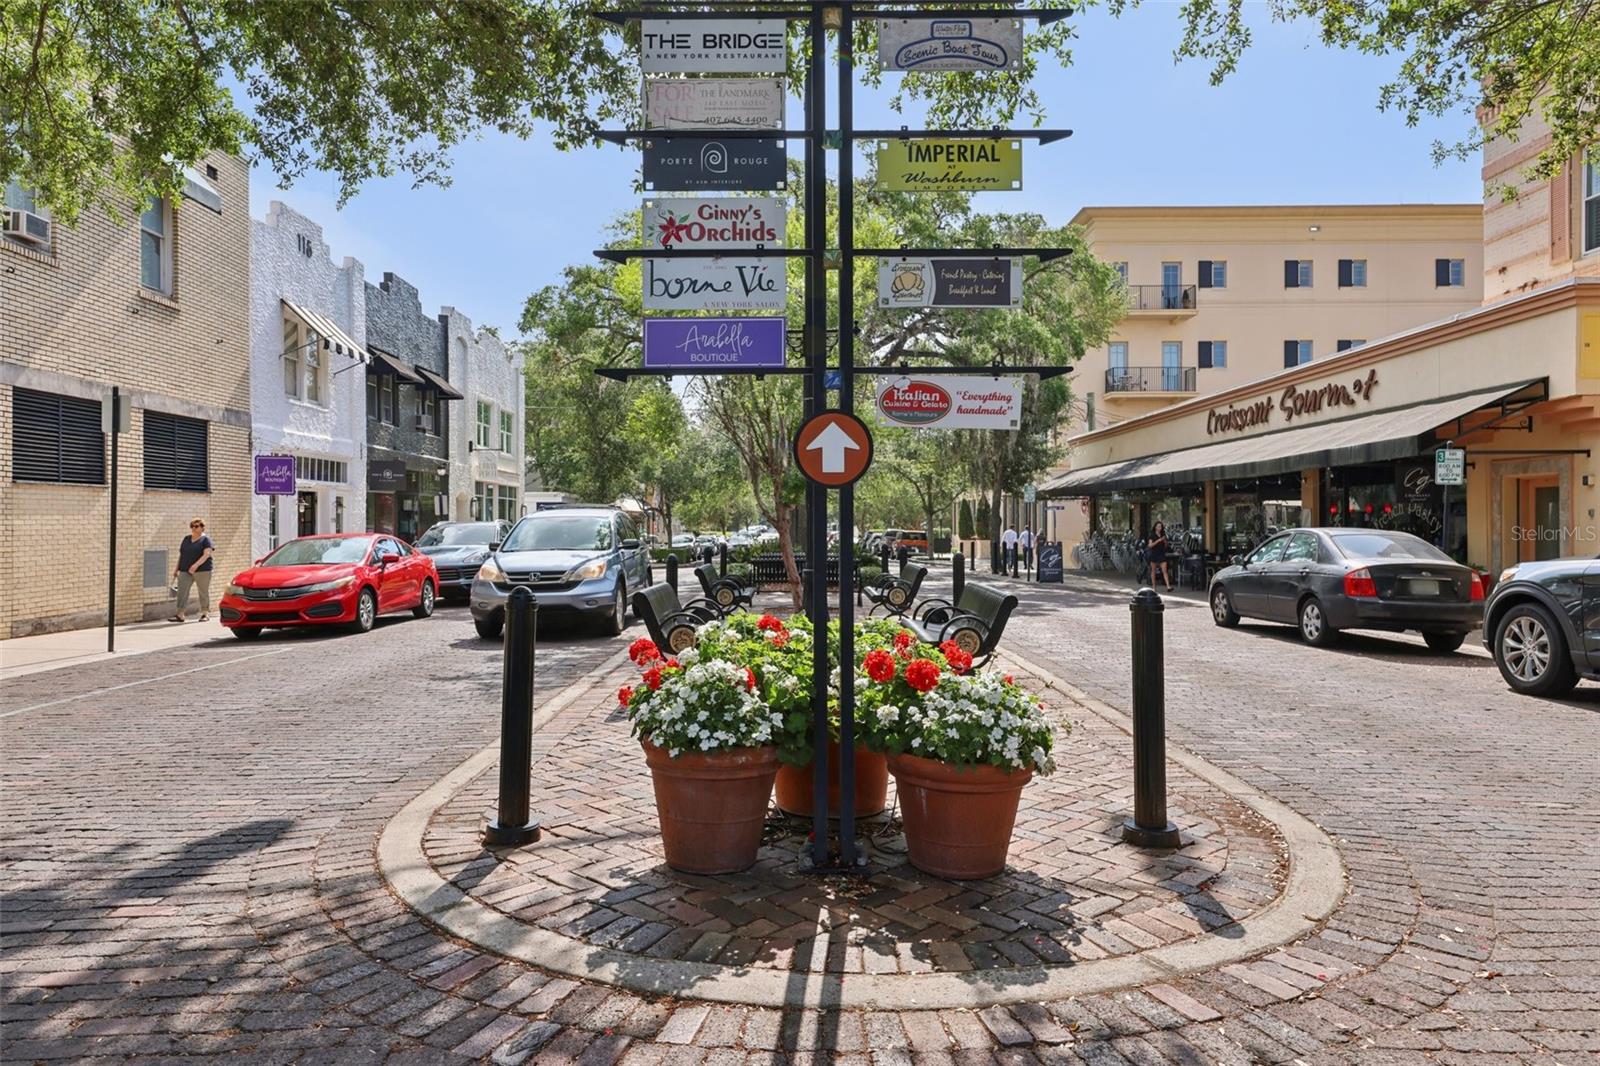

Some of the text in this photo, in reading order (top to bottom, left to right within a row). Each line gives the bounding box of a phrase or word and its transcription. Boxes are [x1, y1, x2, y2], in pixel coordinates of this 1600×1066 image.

[644, 34, 783, 49] THE BRIDGE
[904, 40, 999, 63] Scenic Boat Tour
[655, 85, 694, 101] FOR
[700, 86, 770, 100] THE LANDMARK
[908, 144, 1001, 162] IMPERIAL
[734, 157, 768, 165] ROUGE
[901, 171, 1000, 184] Washburn
[685, 221, 777, 242] Orchids
[648, 259, 779, 299] bonne Vie
[675, 322, 753, 356] Arabella
[690, 353, 738, 362] BOUTIQUE
[893, 389, 940, 400] Italian
[883, 400, 911, 408] Cuisine
[921, 400, 948, 408] Gelato
[1207, 396, 1274, 435] Croissant
[1438, 451, 1444, 462] 3
